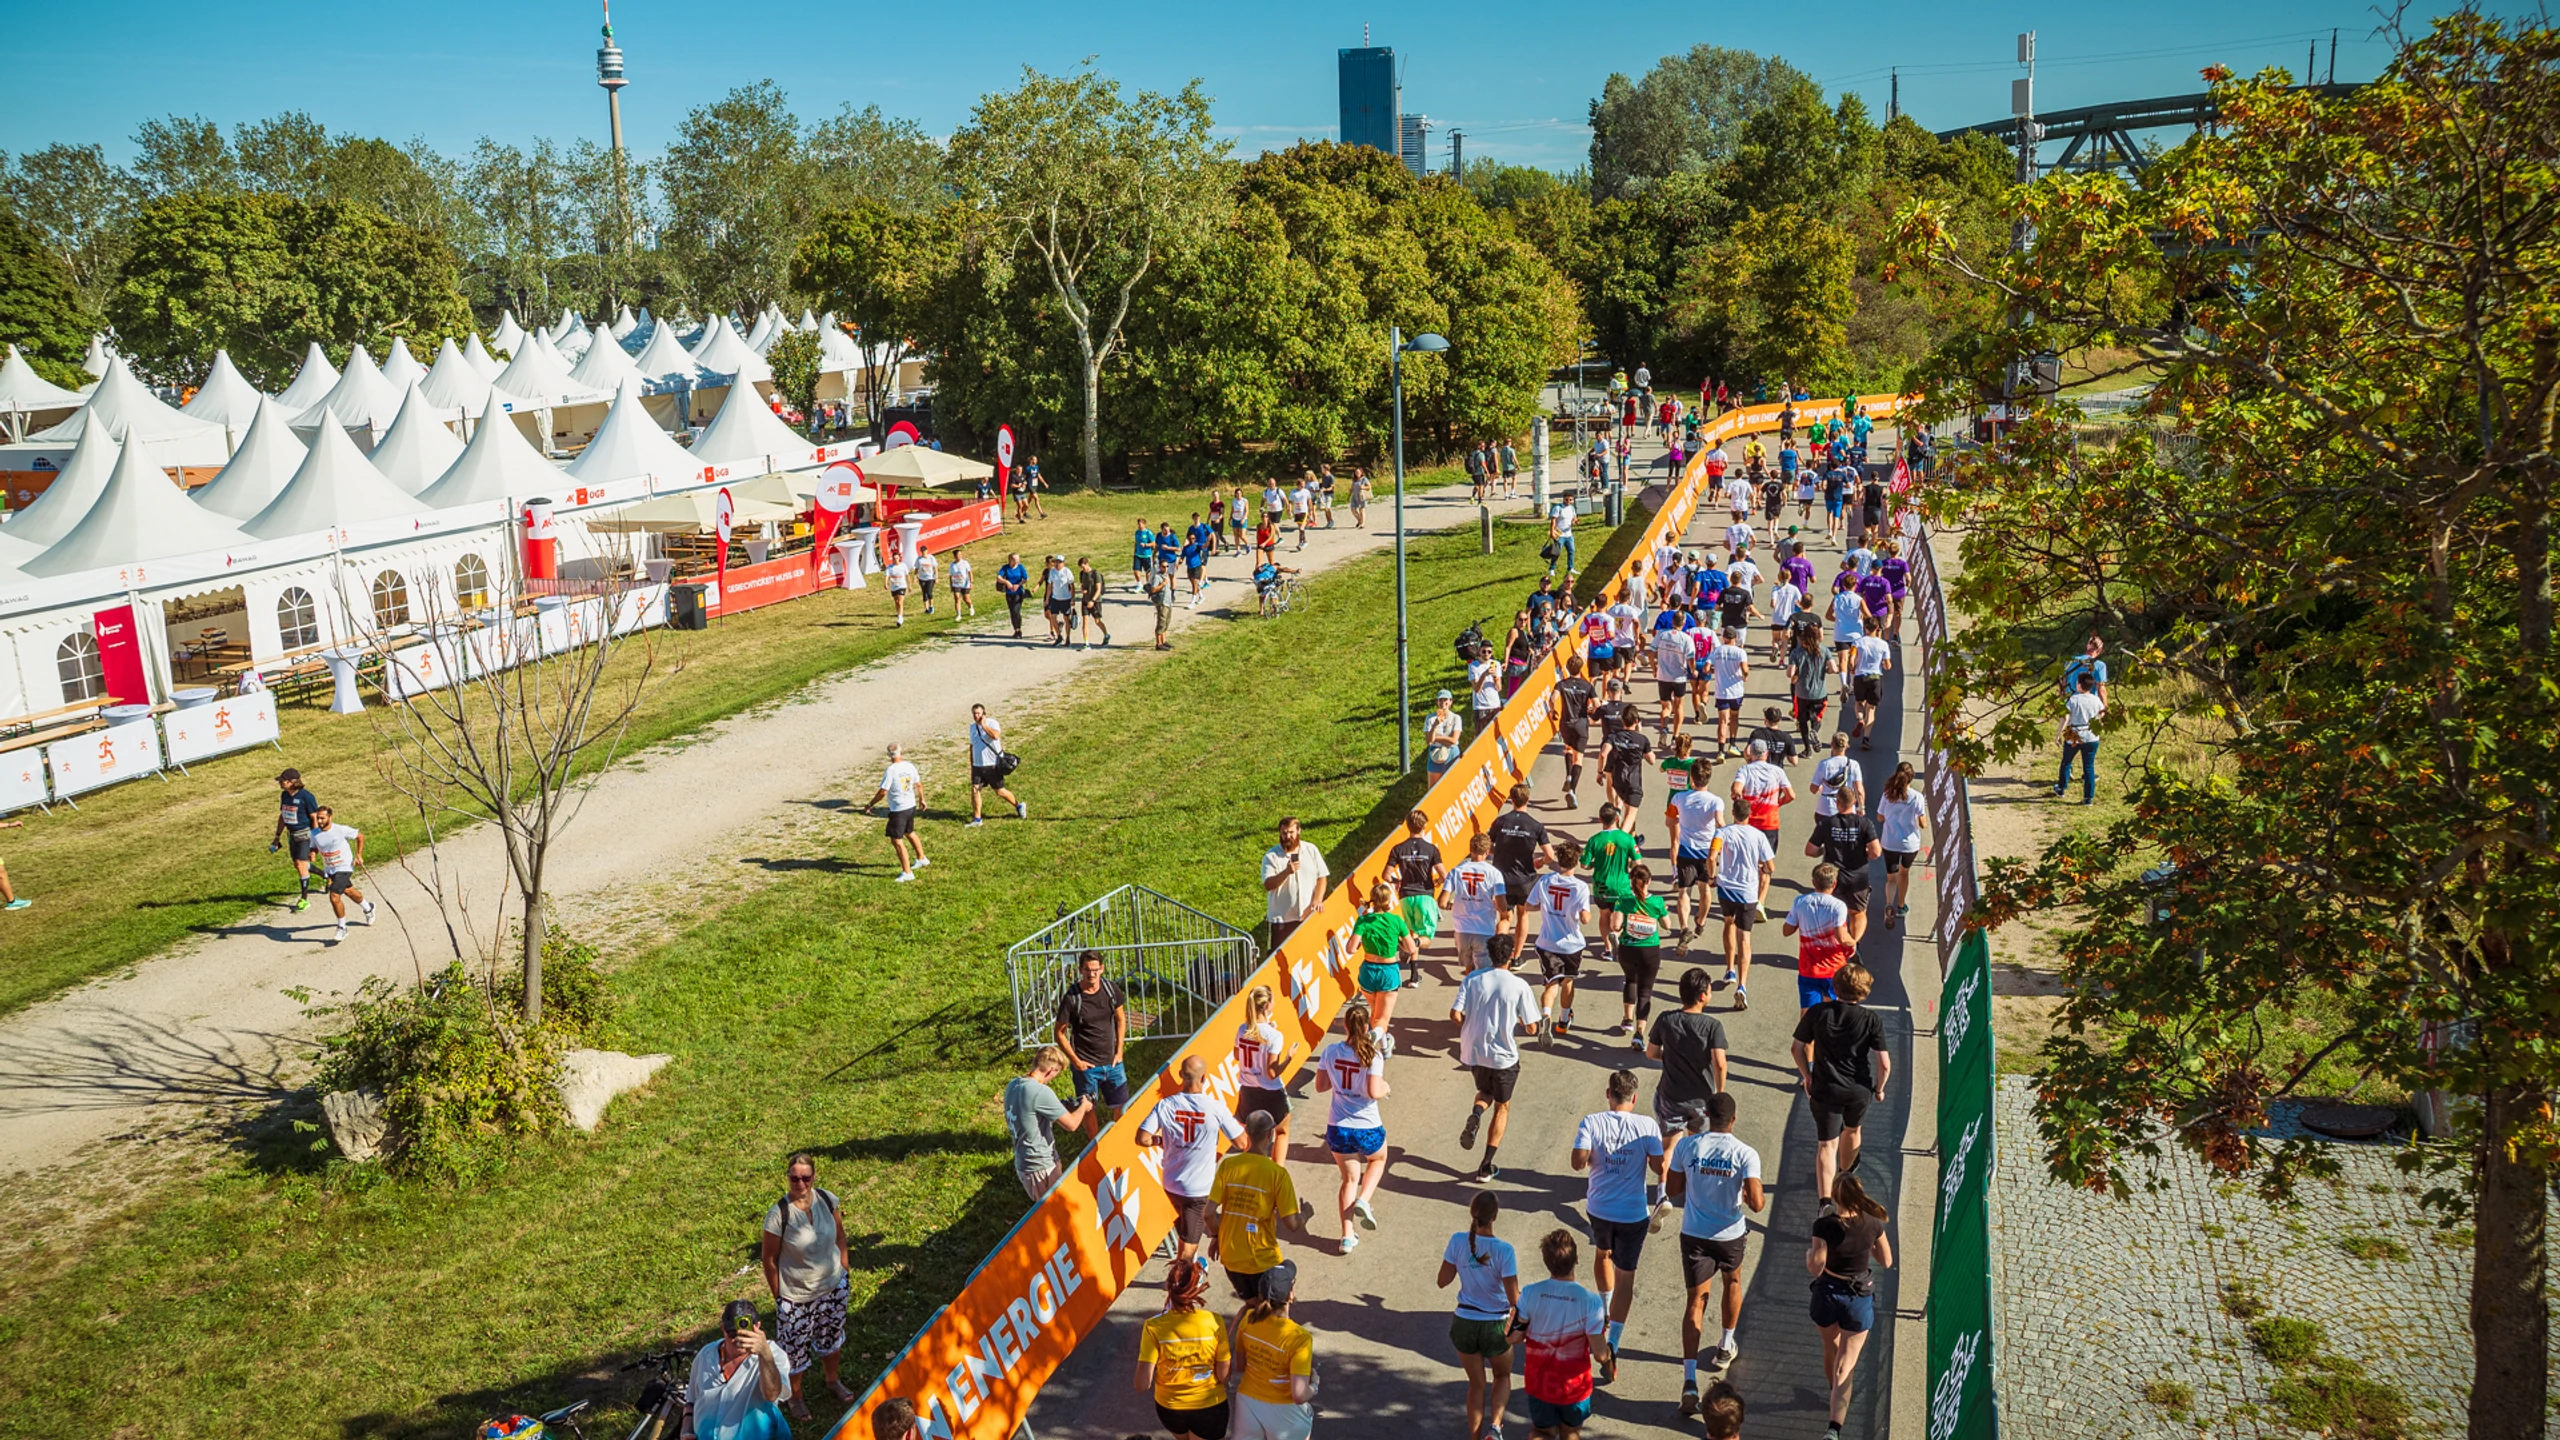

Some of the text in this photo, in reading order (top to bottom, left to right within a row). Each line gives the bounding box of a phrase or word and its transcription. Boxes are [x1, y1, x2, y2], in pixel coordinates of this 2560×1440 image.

[1508, 723, 1532, 752] WIEN
[1434, 760, 1498, 846] WIEN ENERGIE
[1605, 1156, 1627, 1166] Build
[1701, 1157, 1732, 1169] DIGITAL
[1700, 1167, 1732, 1178] RUNWAY
[945, 1242, 1083, 1424] ENERGIE
